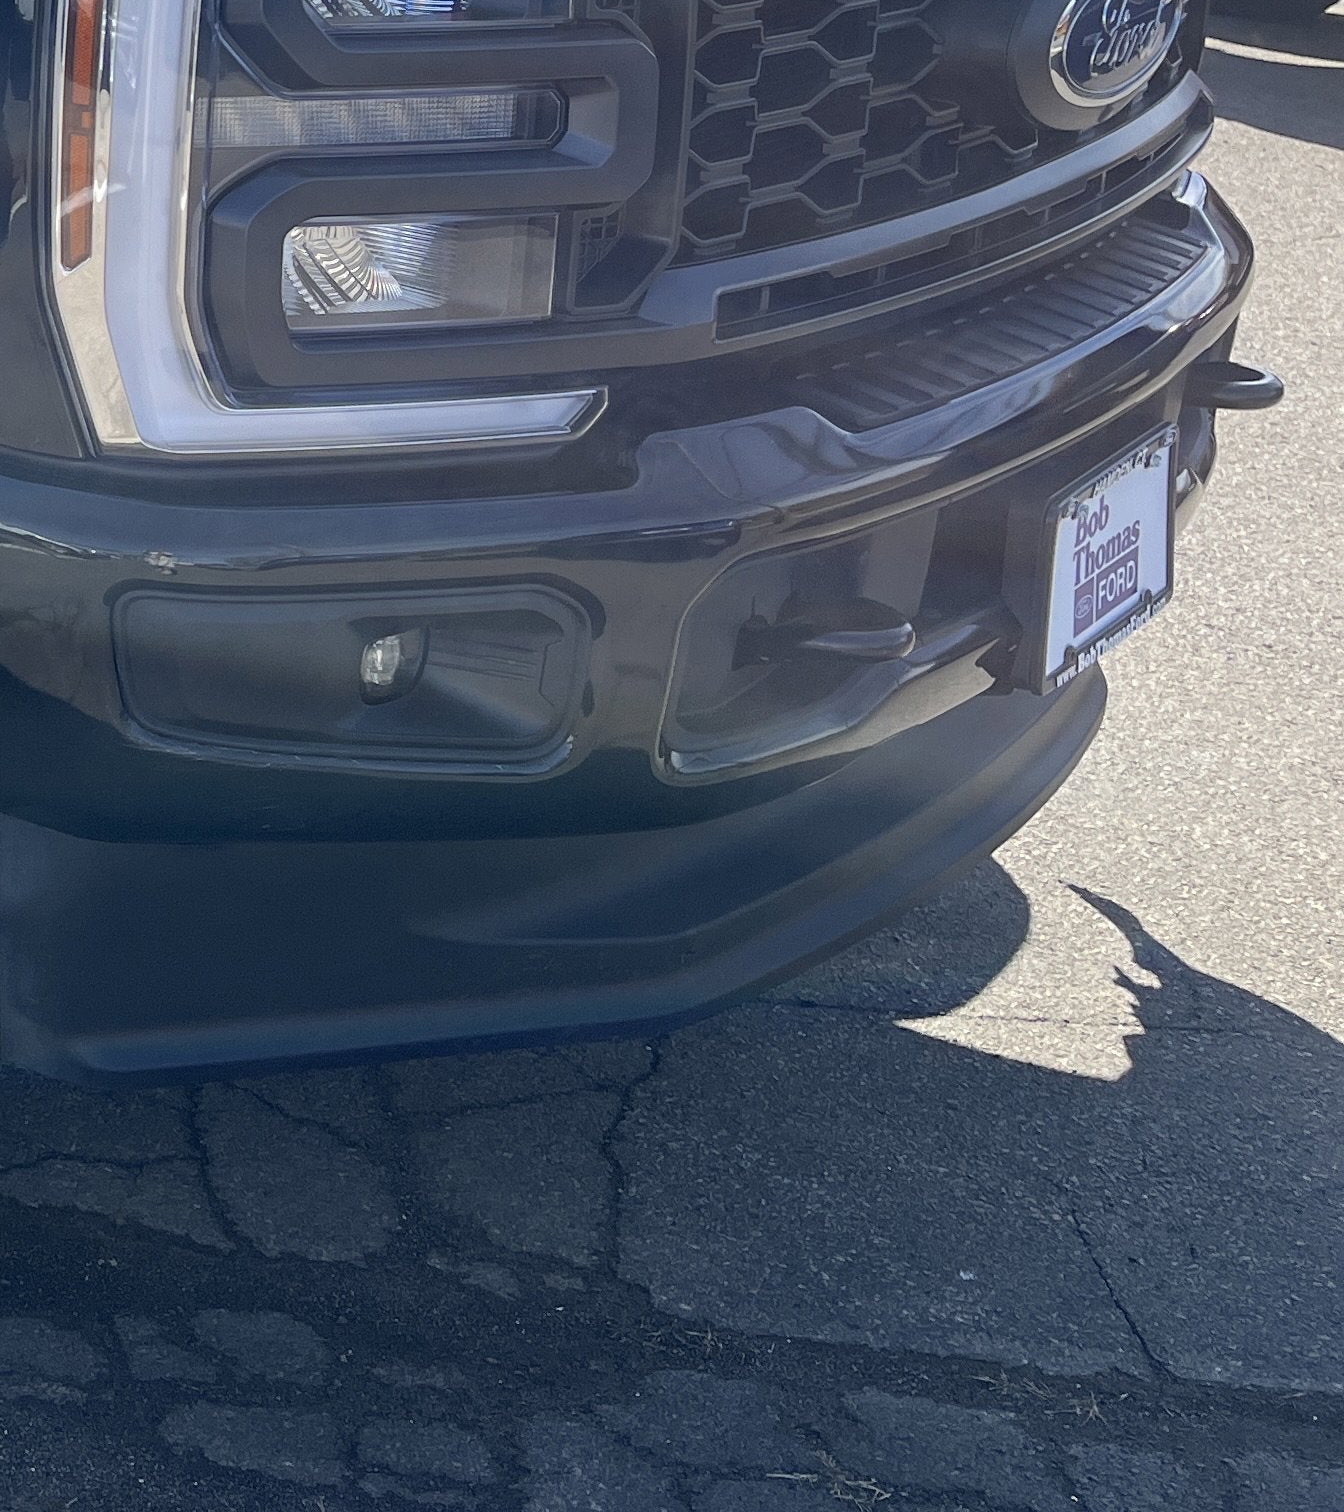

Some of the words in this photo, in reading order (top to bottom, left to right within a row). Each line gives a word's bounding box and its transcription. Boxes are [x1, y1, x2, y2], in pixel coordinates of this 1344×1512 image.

[1074, 494, 1110, 548] Bob
[1073, 520, 1141, 587] Thomas
[1098, 560, 1136, 610] FORD
